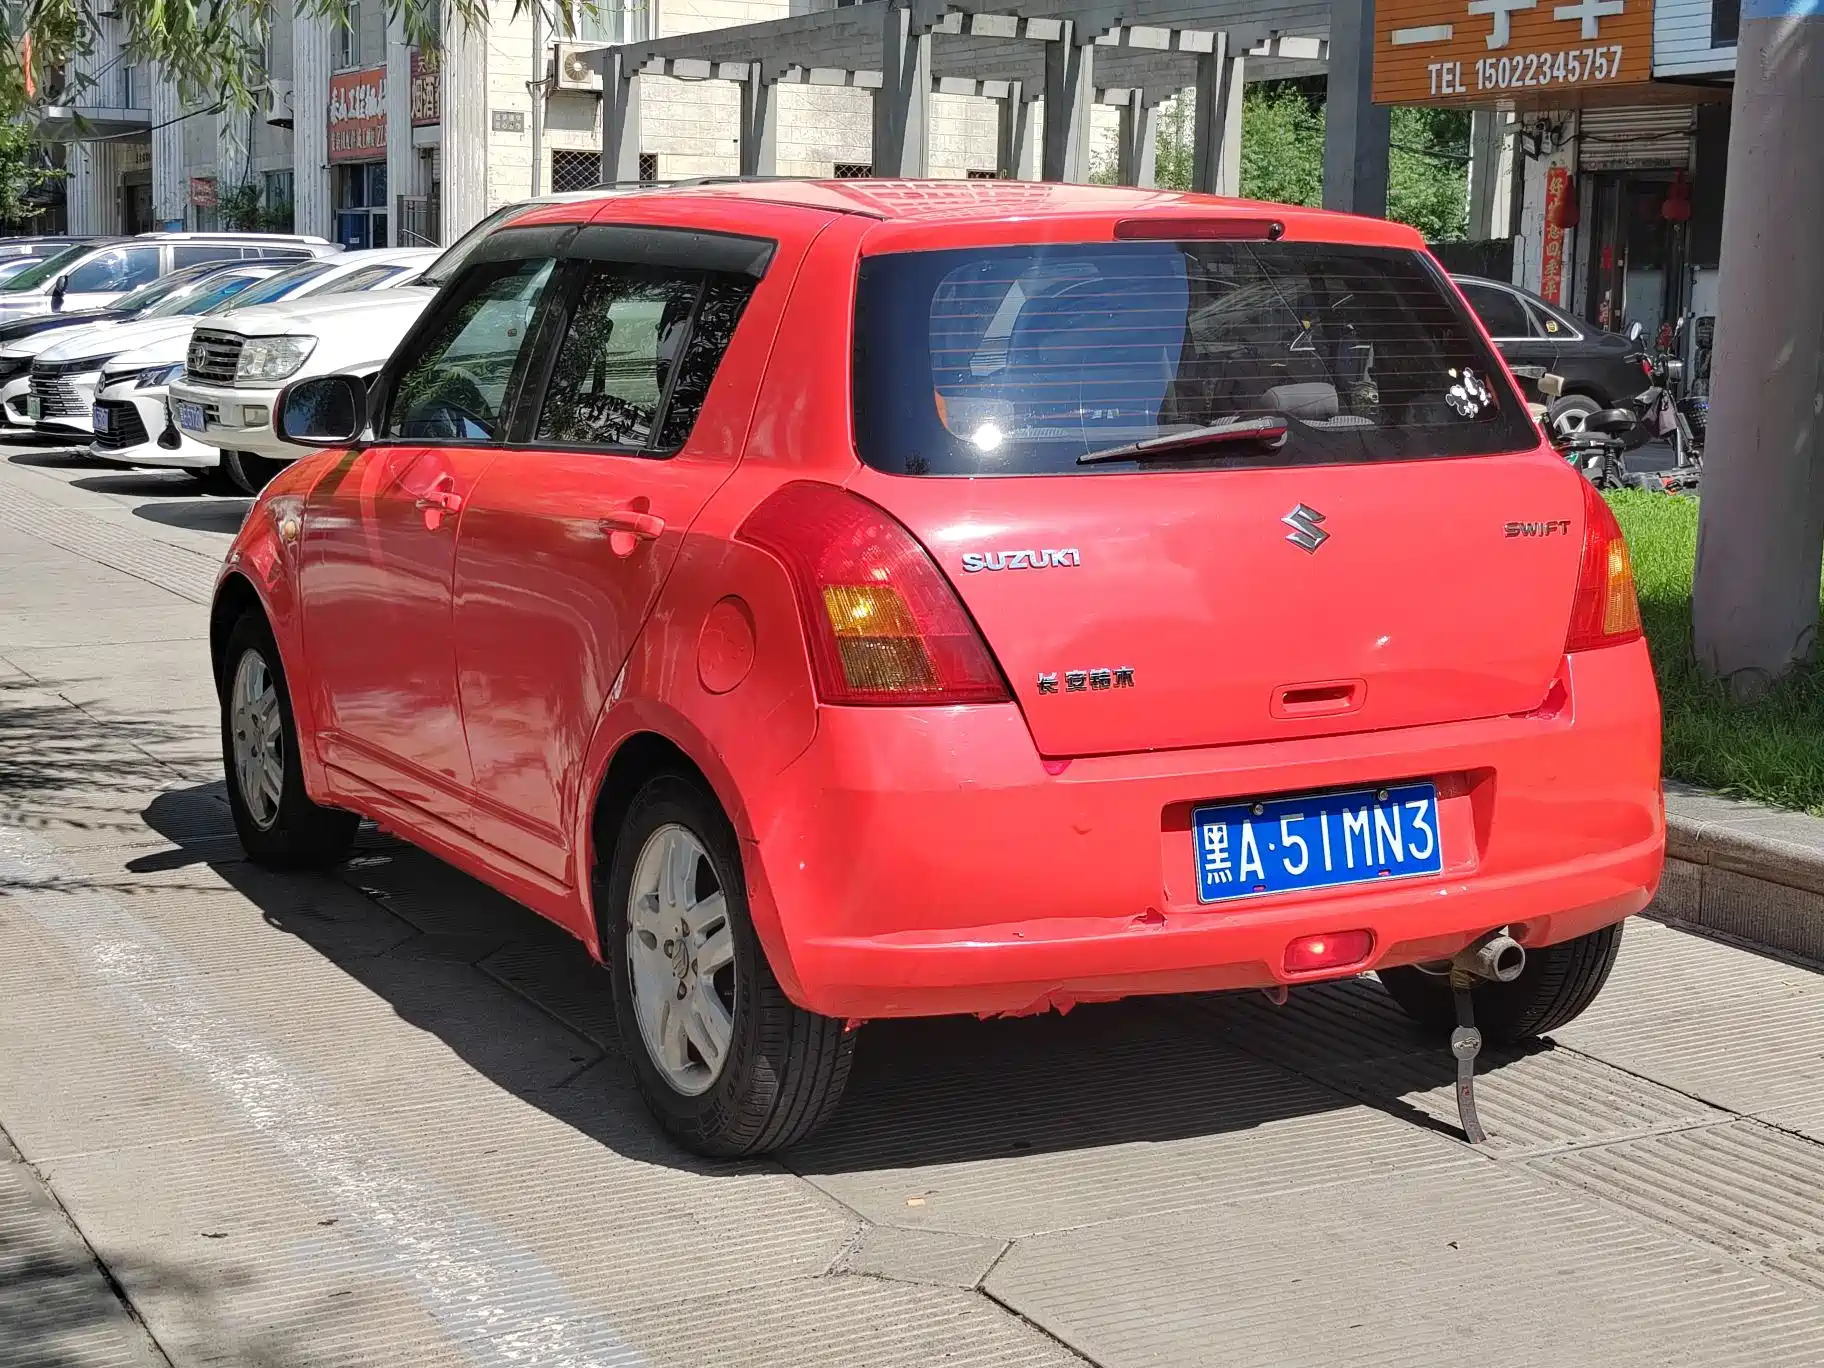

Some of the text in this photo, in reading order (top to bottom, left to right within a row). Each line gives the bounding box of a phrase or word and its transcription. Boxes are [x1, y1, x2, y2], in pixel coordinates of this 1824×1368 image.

[1428, 45, 1623, 95] TEL 15022345757
[1504, 520, 1571, 538] SWIFT
[962, 548, 1081, 573] SUZUKI
[1037, 667, 1135, 695] 长安铃木
